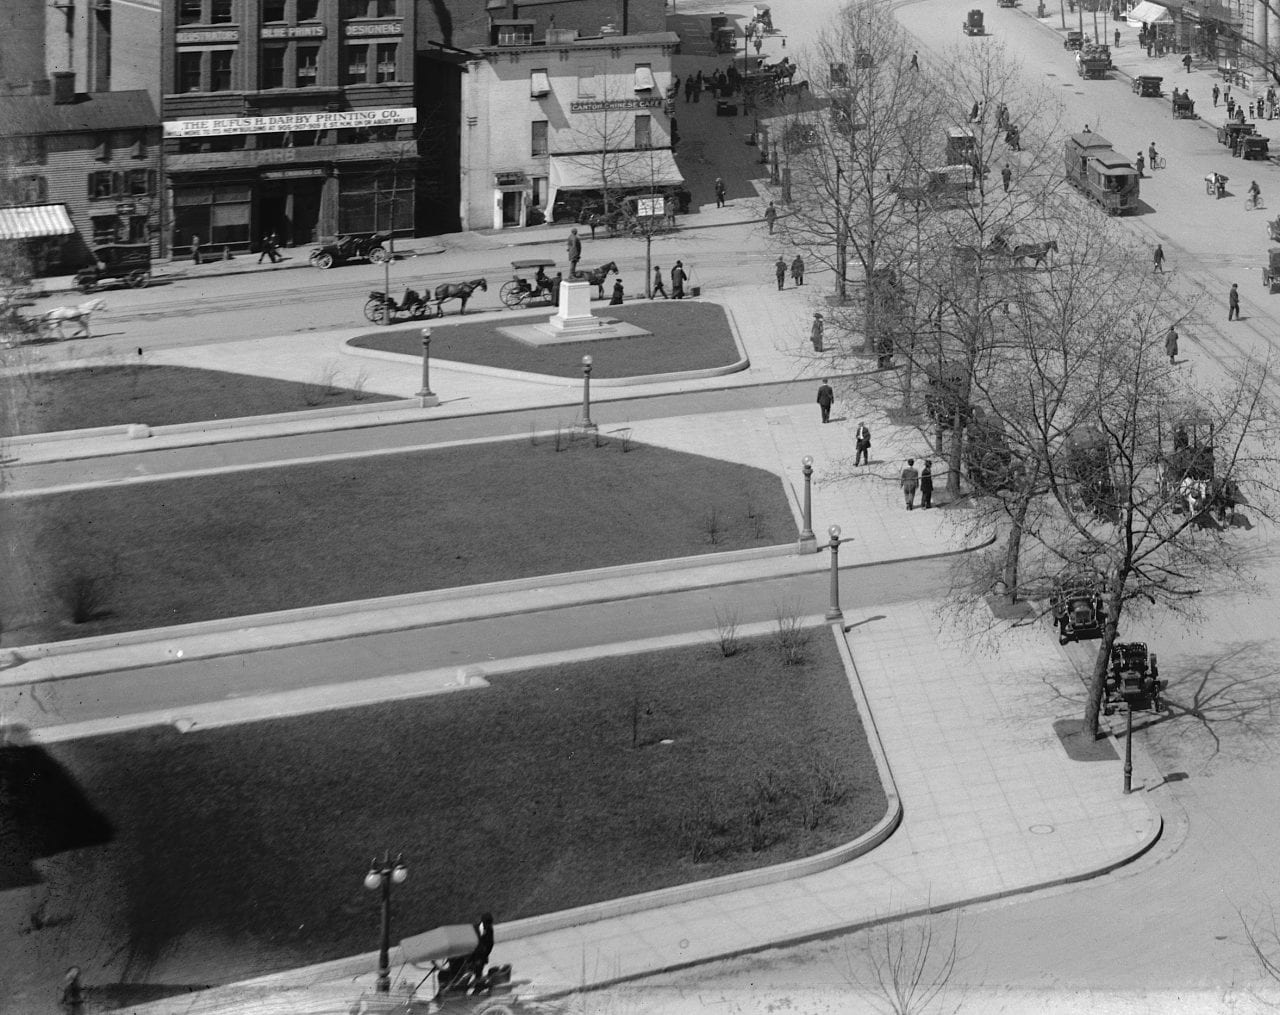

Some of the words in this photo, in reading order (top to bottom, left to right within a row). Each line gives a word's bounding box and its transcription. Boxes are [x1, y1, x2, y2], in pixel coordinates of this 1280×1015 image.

[261, 27, 287, 38] BLUE
[289, 26, 325, 37] PRINTS
[346, 23, 402, 36] DESIGNERS
[184, 120, 209, 130] THE
[213, 118, 252, 128] RUFUS
[268, 114, 313, 125] DARBY
[316, 111, 376, 122] PRINTING
[381, 109, 400, 119] CO.
